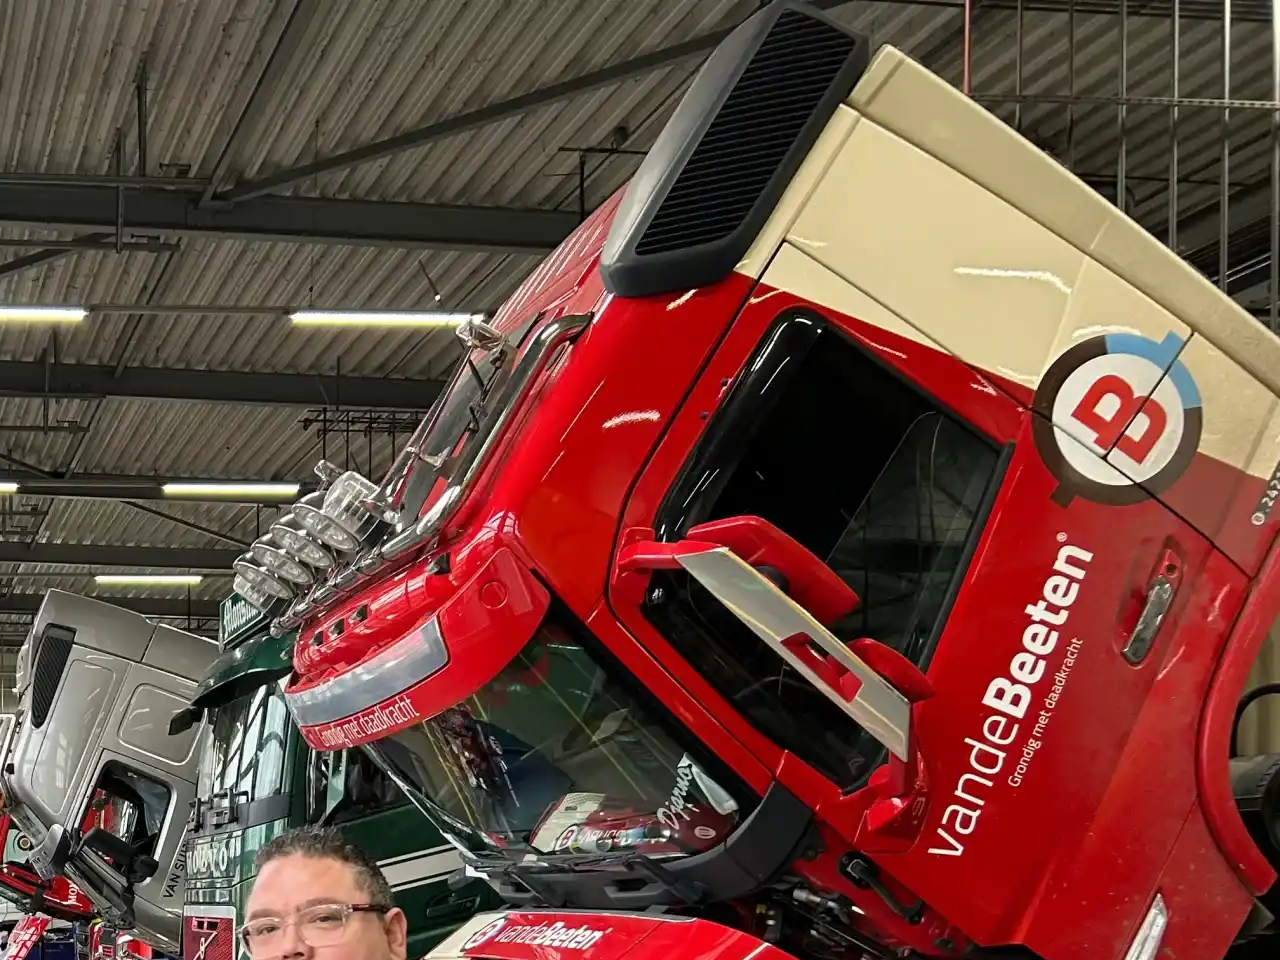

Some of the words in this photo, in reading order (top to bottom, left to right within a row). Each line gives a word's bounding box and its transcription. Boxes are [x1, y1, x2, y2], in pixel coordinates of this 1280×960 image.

[342, 717, 366, 741] met
[358, 694, 420, 735] daadkracht
[1007, 738, 1042, 788] Grondig
[1032, 709, 1052, 737] met
[1043, 636, 1084, 709] daadkracht
[163, 872, 181, 898] VAN
